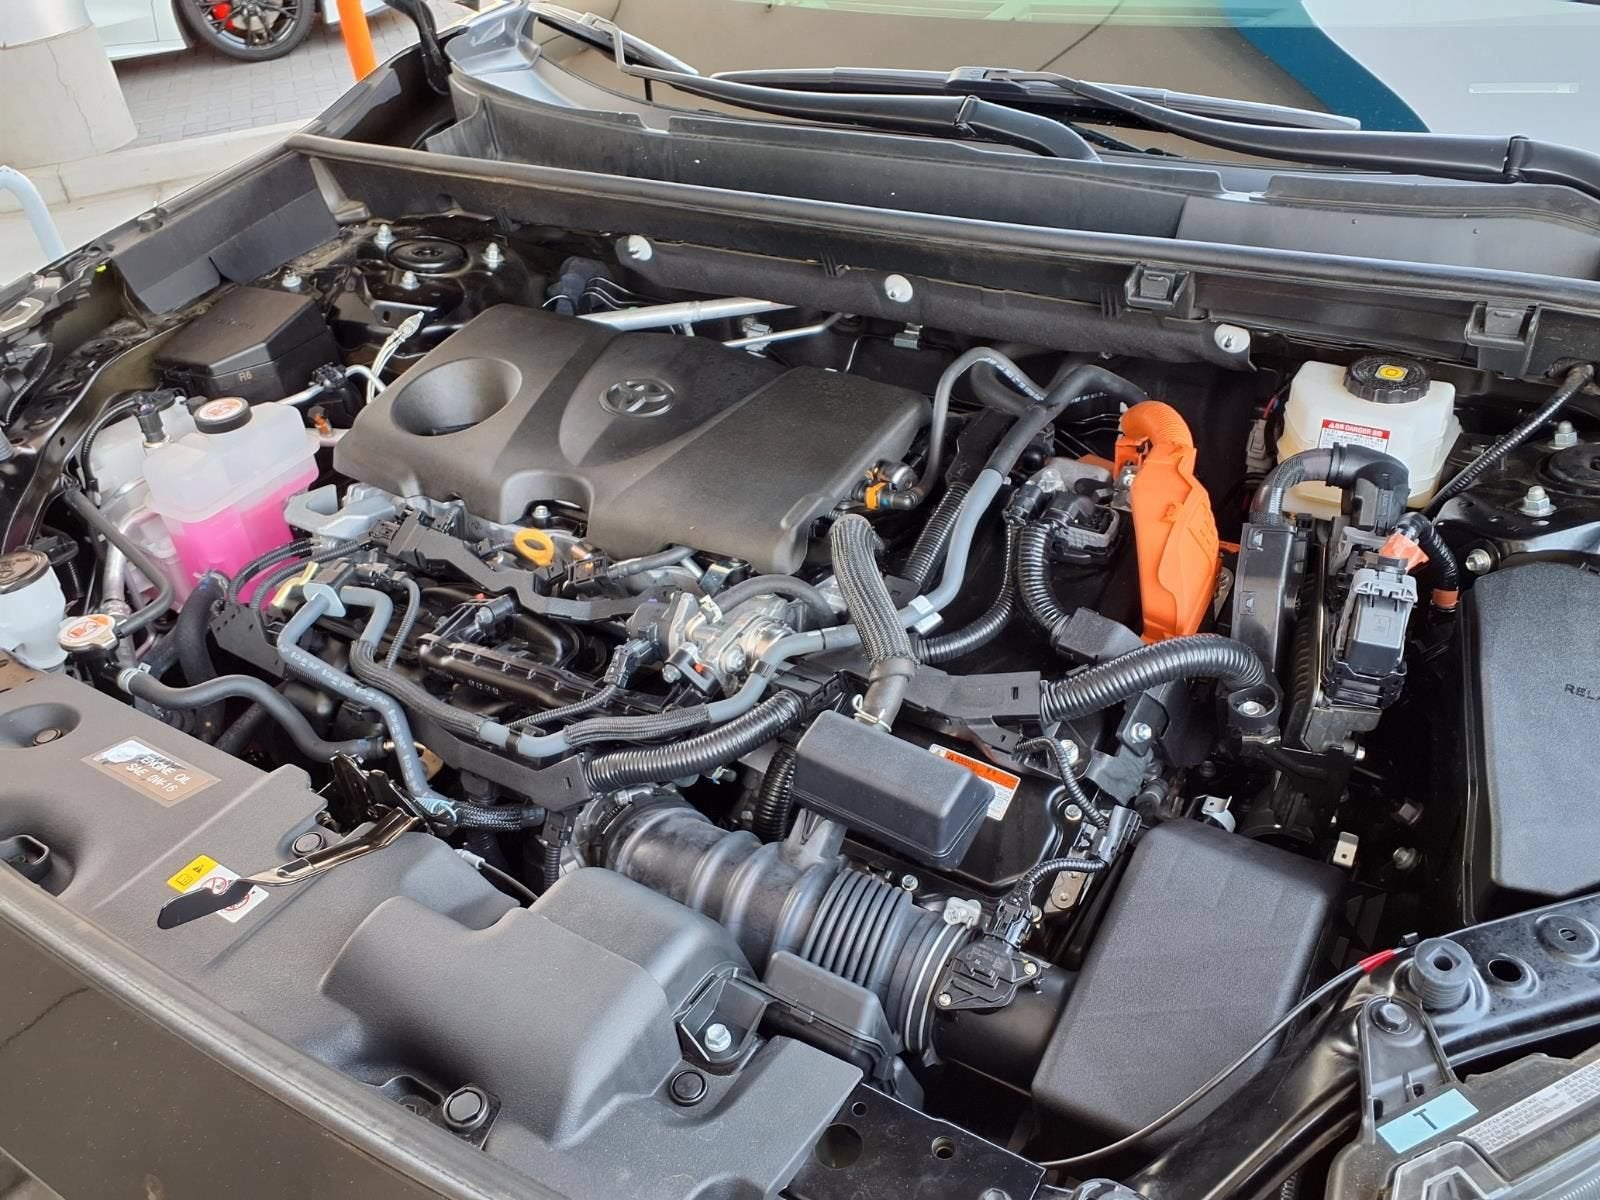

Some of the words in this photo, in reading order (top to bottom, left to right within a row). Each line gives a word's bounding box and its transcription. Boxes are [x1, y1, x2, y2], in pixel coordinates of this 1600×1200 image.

[1344, 424, 1372, 435] DANGER
[1565, 683, 1600, 701] REL
[126, 763, 149, 777] SAE
[141, 755, 177, 776] ENGINE
[174, 770, 192, 785] OIL
[1413, 1108, 1438, 1130] T
